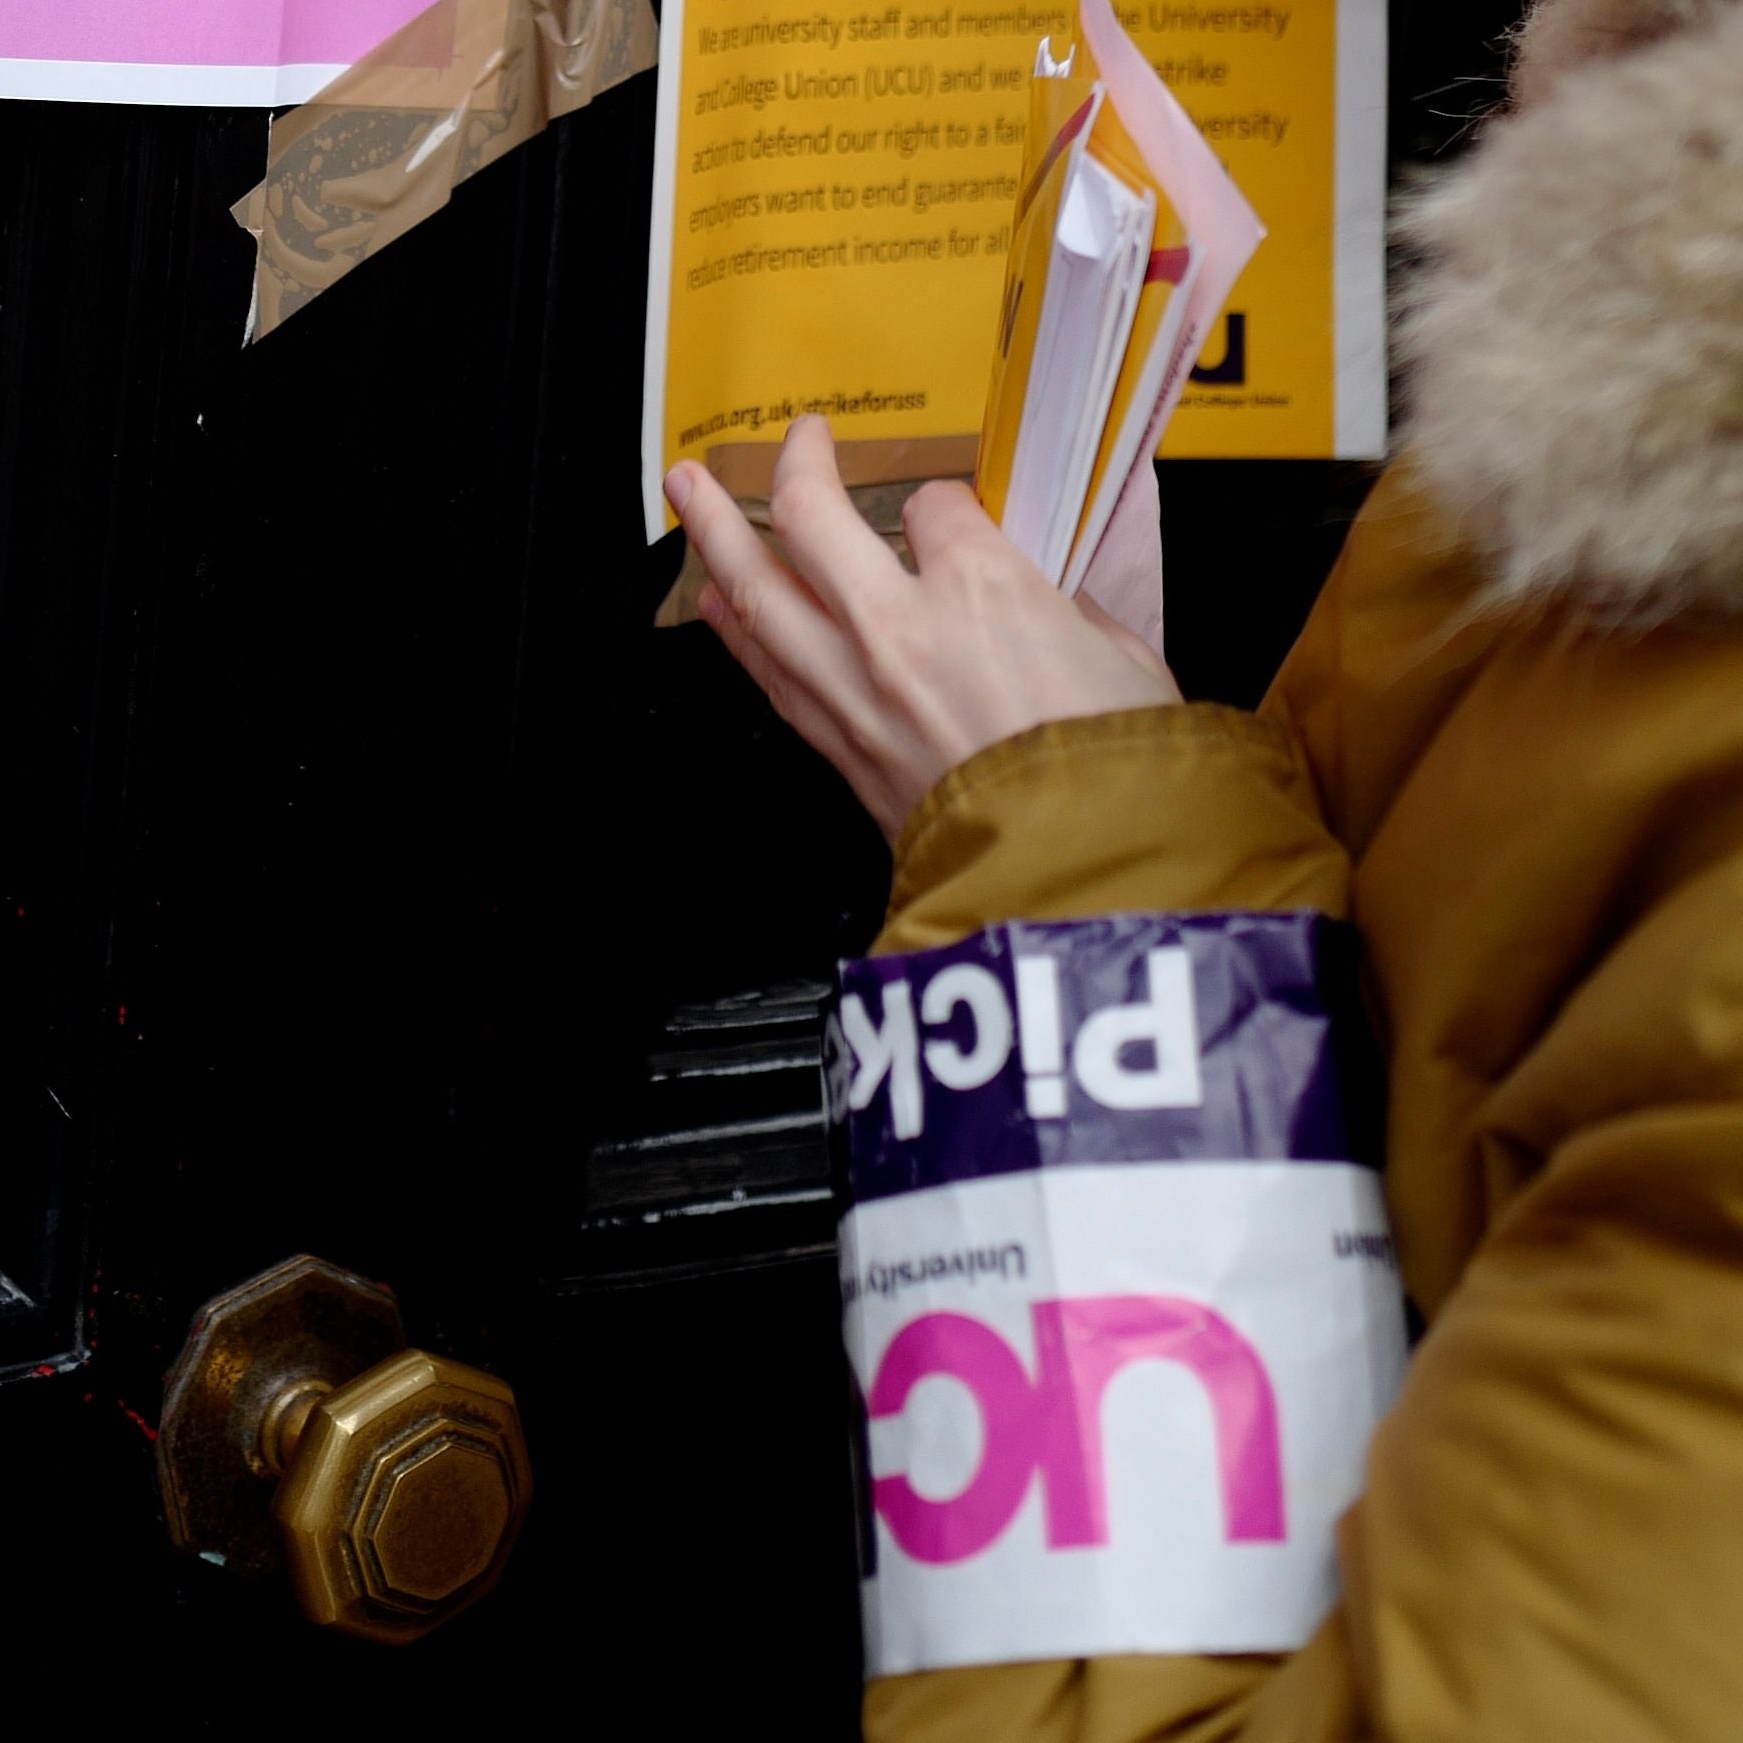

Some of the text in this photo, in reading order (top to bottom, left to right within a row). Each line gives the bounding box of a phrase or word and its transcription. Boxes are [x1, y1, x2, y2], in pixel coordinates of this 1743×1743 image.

[741, 14, 844, 51] university
[848, 8, 902, 41] staff
[906, 6, 952, 40] and
[958, 4, 1068, 36] members
[1148, 2, 1293, 42] University
[784, 68, 858, 101] Union
[865, 63, 935, 104] (UCU)
[938, 60, 987, 95] and
[989, 68, 1024, 94] we
[750, 124, 832, 160] defend
[836, 130, 878, 156] our
[884, 120, 940, 161] right
[946, 122, 970, 149] to
[974, 124, 988, 147] a
[765, 183, 827, 216] want
[832, 184, 856, 212] to
[861, 176, 910, 209] end
[727, 243, 849, 278] retirement
[853, 234, 943, 267] income
[947, 228, 980, 259] for
[863, 1242, 1028, 1299] University
